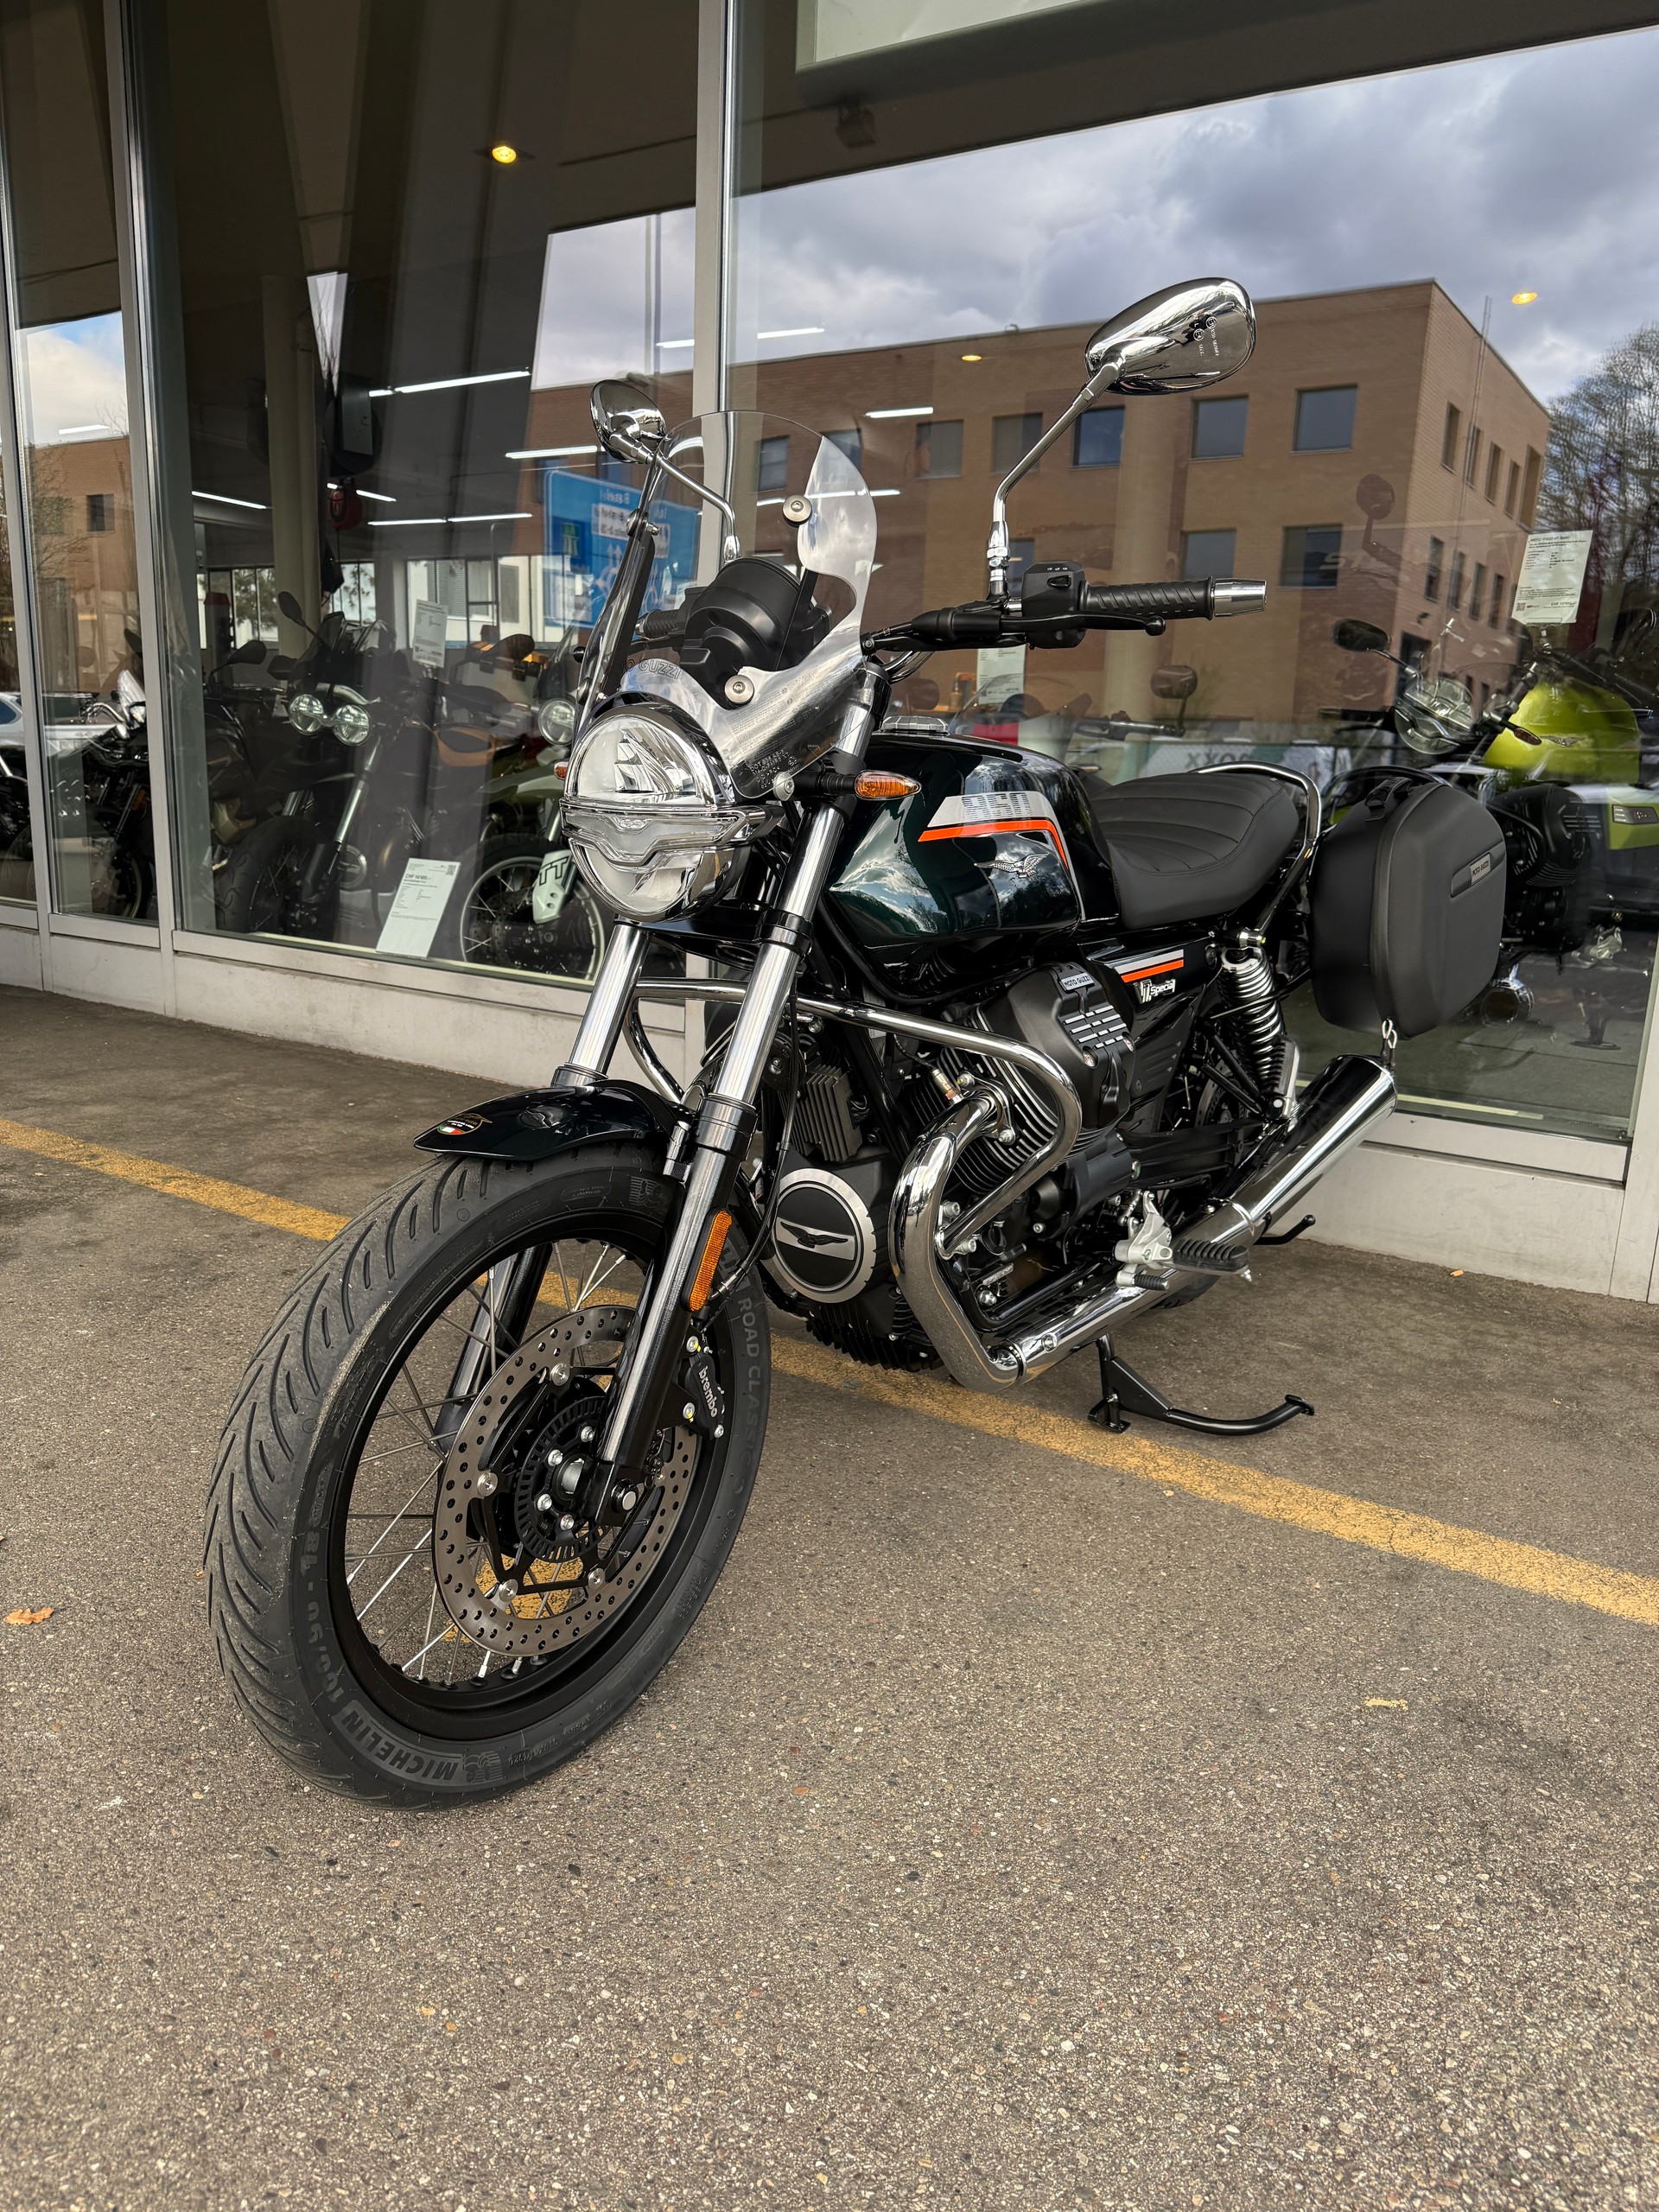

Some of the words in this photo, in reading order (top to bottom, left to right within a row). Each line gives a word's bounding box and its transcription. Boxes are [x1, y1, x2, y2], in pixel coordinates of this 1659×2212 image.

[639, 659, 682, 680] GUZZI
[539, 855, 570, 886] TT
[1064, 977, 1077, 988] MOTO
[1077, 975, 1090, 984] GUZZI
[1150, 978, 1176, 996] Special
[738, 1296, 760, 1357] ROAD
[699, 1365, 718, 1418] brembo
[341, 1709, 460, 1781] MICHELIN
